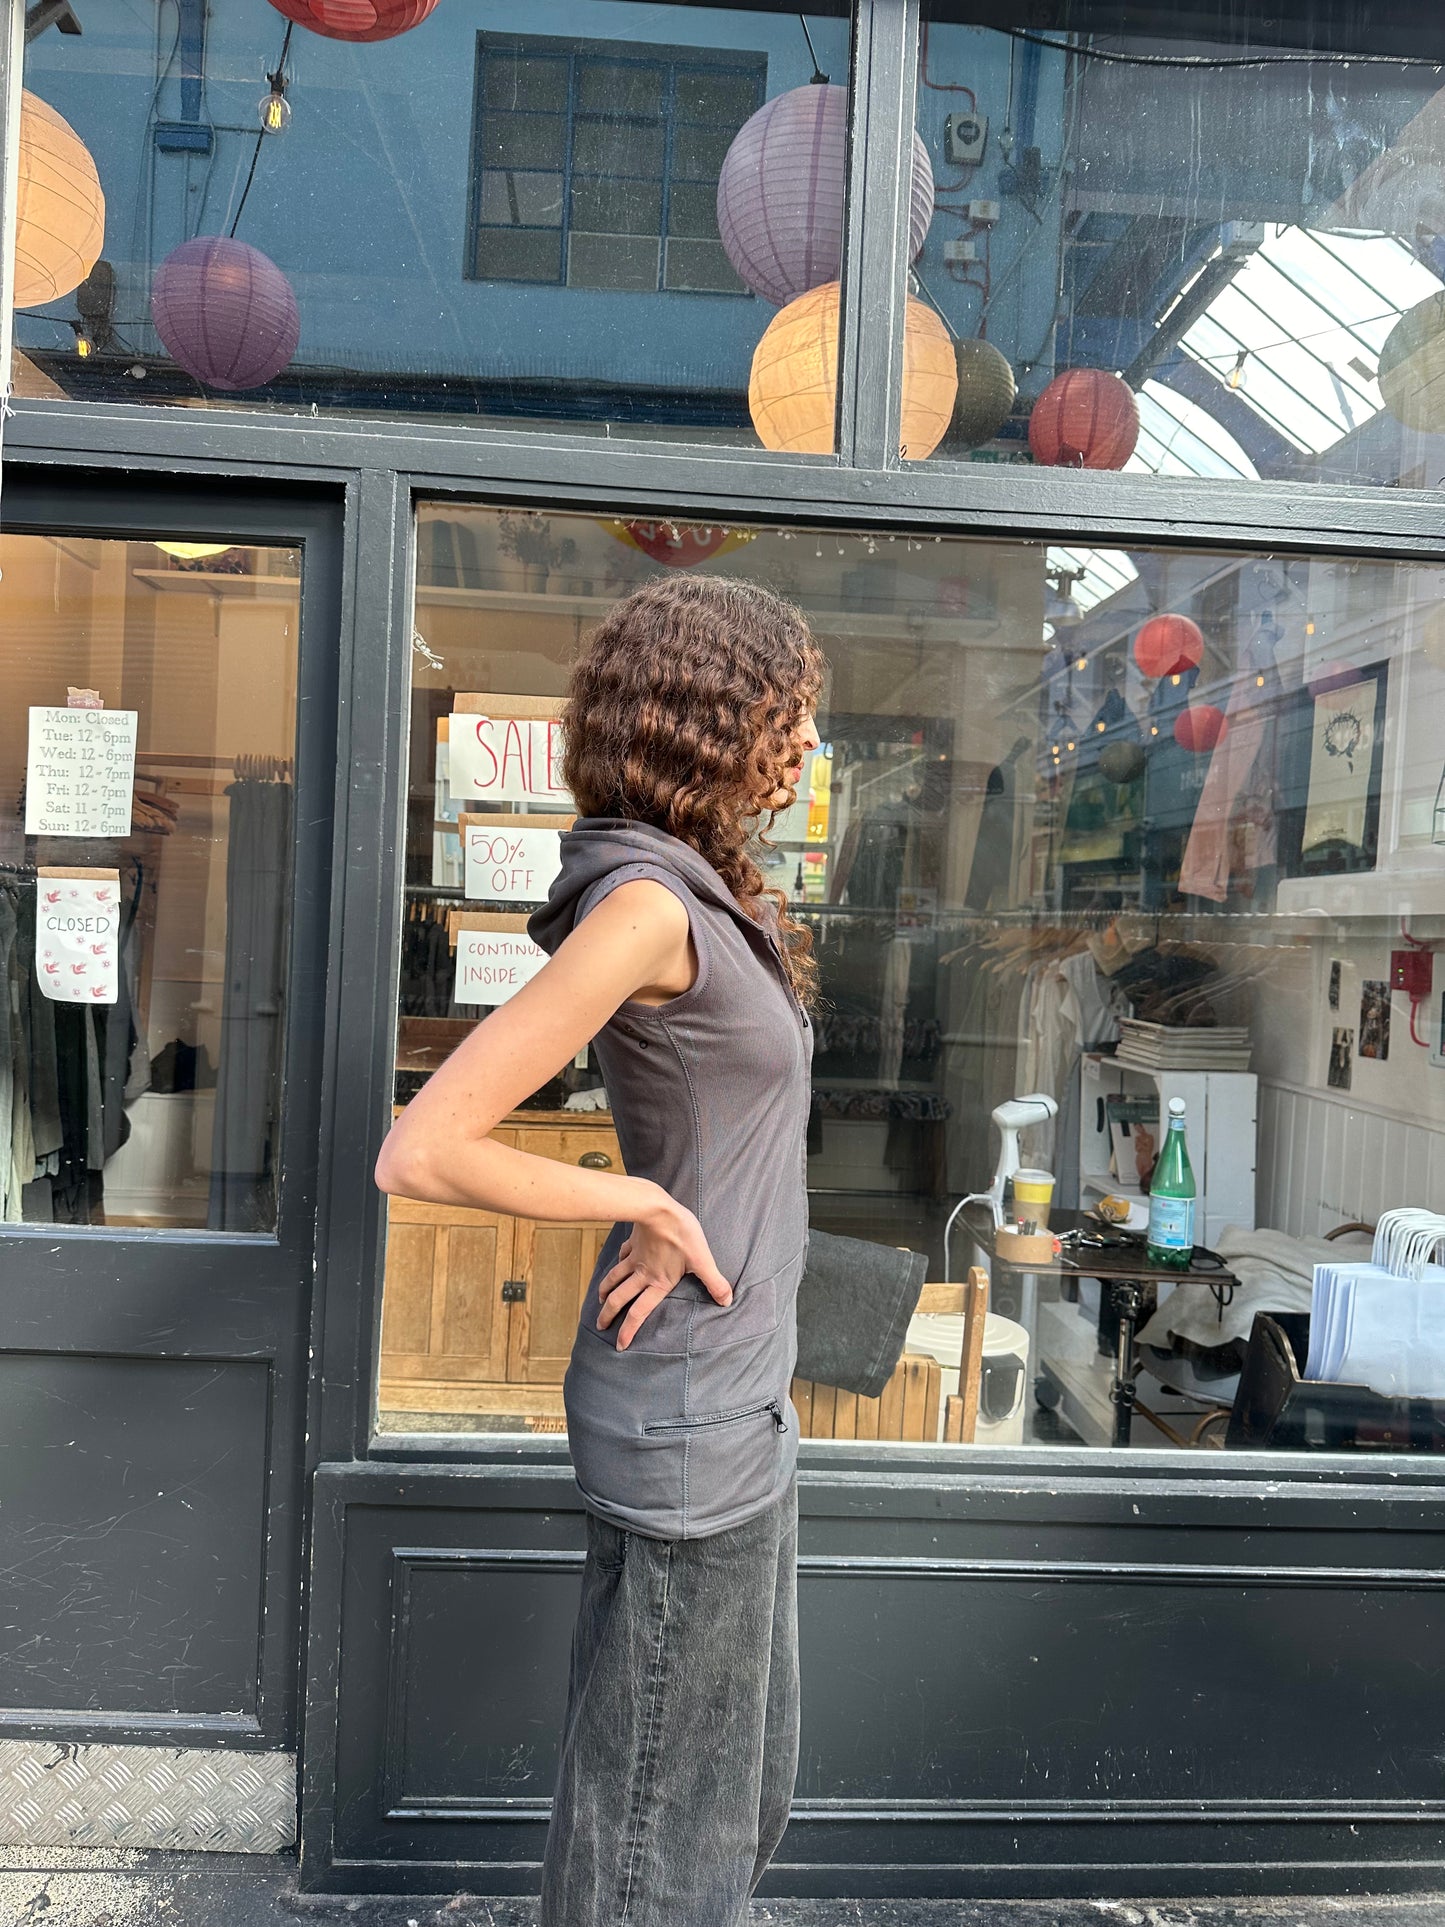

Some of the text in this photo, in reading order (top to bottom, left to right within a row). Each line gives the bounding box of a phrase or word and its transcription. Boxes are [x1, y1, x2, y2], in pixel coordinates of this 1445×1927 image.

[45, 710, 129, 726] Mon: Closed
[42, 728, 73, 741] Tue:
[77, 729, 93, 743] 12
[103, 731, 131, 746] 6pm
[39, 746, 76, 760] Wed:
[81, 748, 95, 760] 12
[106, 749, 133, 764] 6pm
[474, 719, 568, 796] SALE
[35, 764, 69, 778] Thu:
[79, 765, 94, 778] 12
[105, 767, 130, 782] 7pm
[46, 782, 70, 796] Fri:
[75, 783, 90, 796] 12
[101, 785, 127, 800] 7pm
[45, 801, 70, 814] Sat:
[75, 802, 87, 814] 11
[102, 803, 126, 818] 7pm
[38, 819, 70, 832] Sun:
[75, 820, 90, 832] 12
[101, 821, 126, 835] 6pm
[471, 834, 525, 865] 50%
[491, 868, 535, 893] OFF
[46, 916, 111, 934] CLOSED
